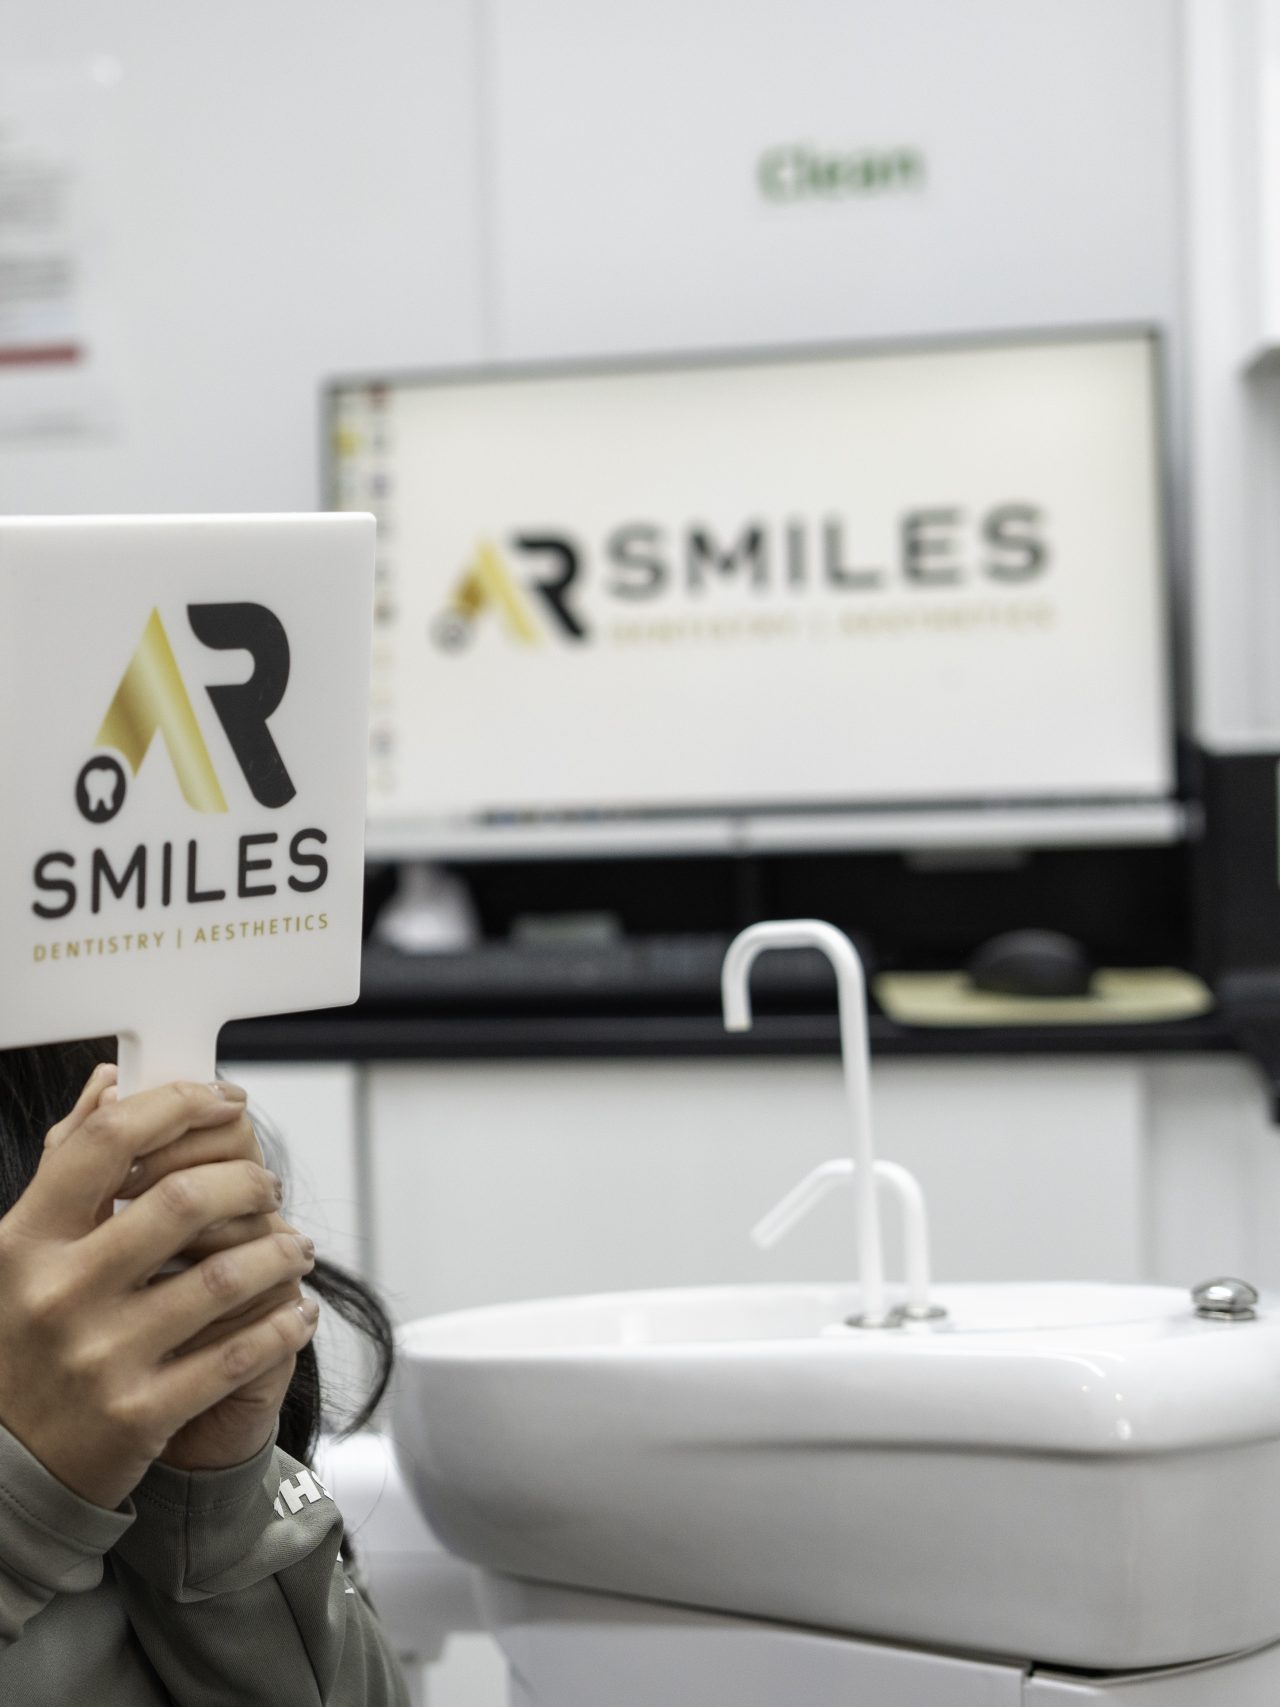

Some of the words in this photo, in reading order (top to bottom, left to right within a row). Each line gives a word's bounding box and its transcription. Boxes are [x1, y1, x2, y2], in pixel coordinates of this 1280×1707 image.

[757, 143, 926, 203] Clean
[444, 531, 591, 648] AR
[605, 502, 1052, 602] SMILES
[88, 601, 298, 816] AR
[31, 827, 330, 920] SMILES
[32, 931, 165, 962] DENTISTRY
[194, 912, 330, 945] AESTHETICS
